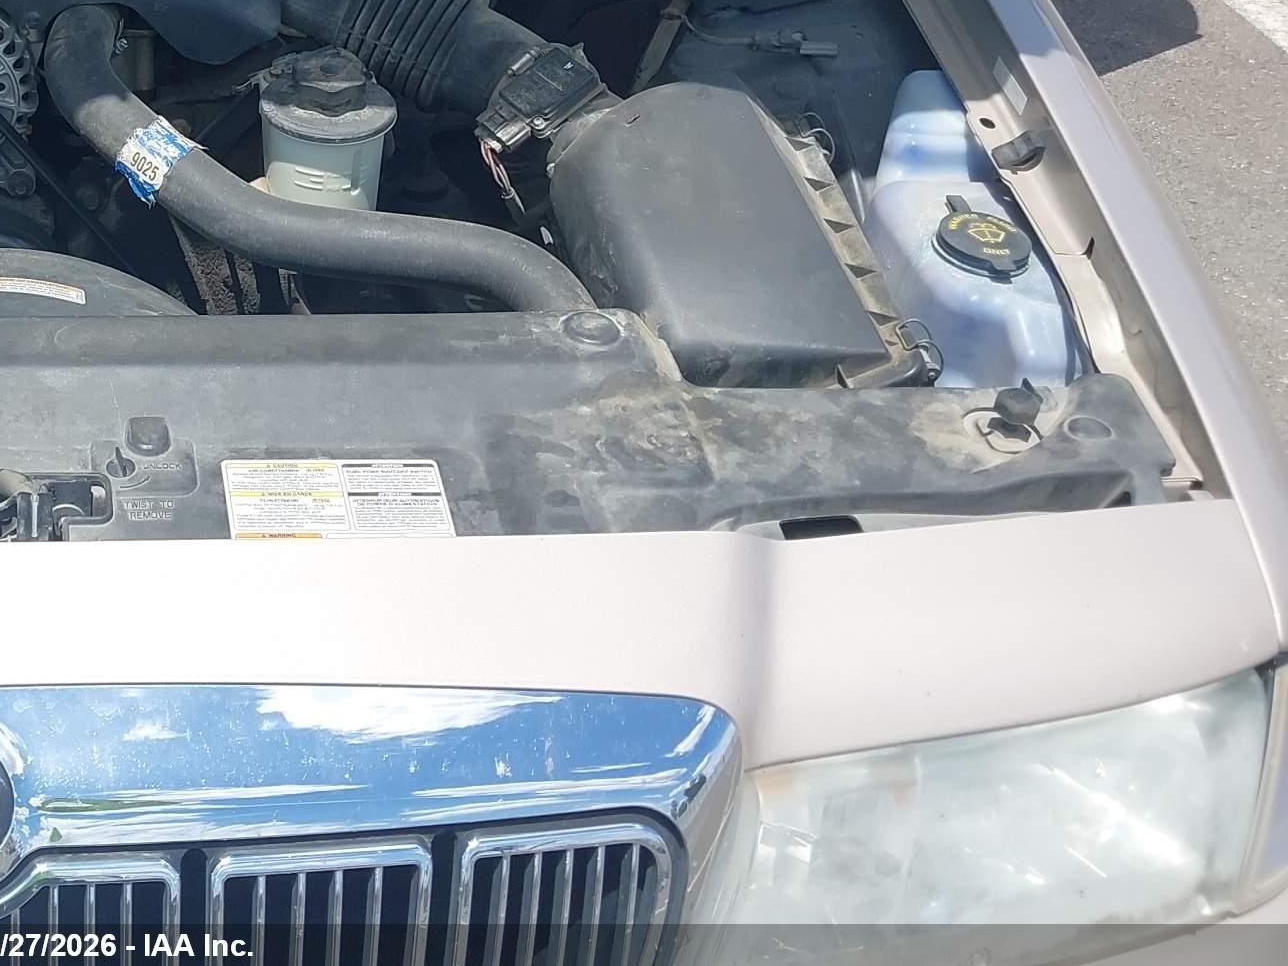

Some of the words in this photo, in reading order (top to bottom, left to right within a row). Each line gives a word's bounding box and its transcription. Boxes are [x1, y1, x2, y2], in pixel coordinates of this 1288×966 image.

[130, 151, 160, 181] 9025
[983, 247, 1011, 255] ONLY
[143, 461, 183, 471] UNLOCK
[124, 500, 155, 510] TWIST
[160, 500, 175, 510] TO
[129, 511, 173, 521] REMOVE
